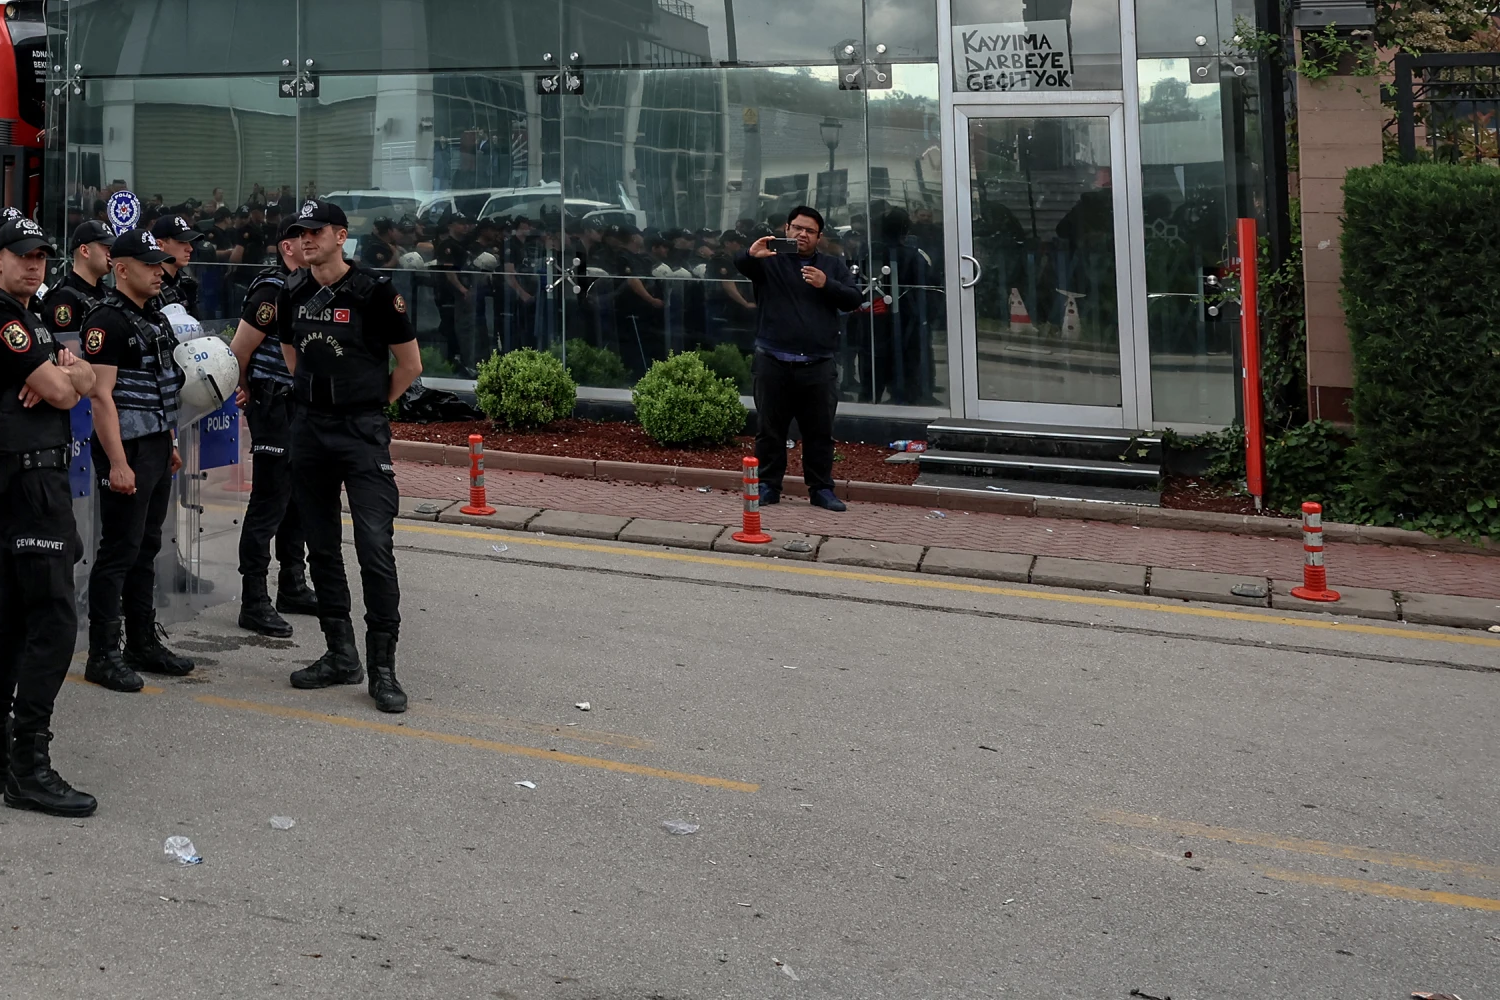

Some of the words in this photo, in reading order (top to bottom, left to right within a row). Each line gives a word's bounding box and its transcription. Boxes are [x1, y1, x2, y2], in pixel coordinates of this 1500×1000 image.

[961, 29, 1053, 55] KAYYIMA
[964, 51, 1064, 74] DARBEYE
[1034, 69, 1071, 88] YOK
[115, 192, 133, 200] POLİS
[22, 229, 43, 237] POLİS
[300, 331, 323, 353] ANKARA
[326, 335, 344, 357] ÇEVİK
[193, 350, 209, 363] 06
[207, 411, 230, 433] POLİS
[16, 538, 36, 549] ÇEVİK
[36, 538, 64, 550] KUVVET
